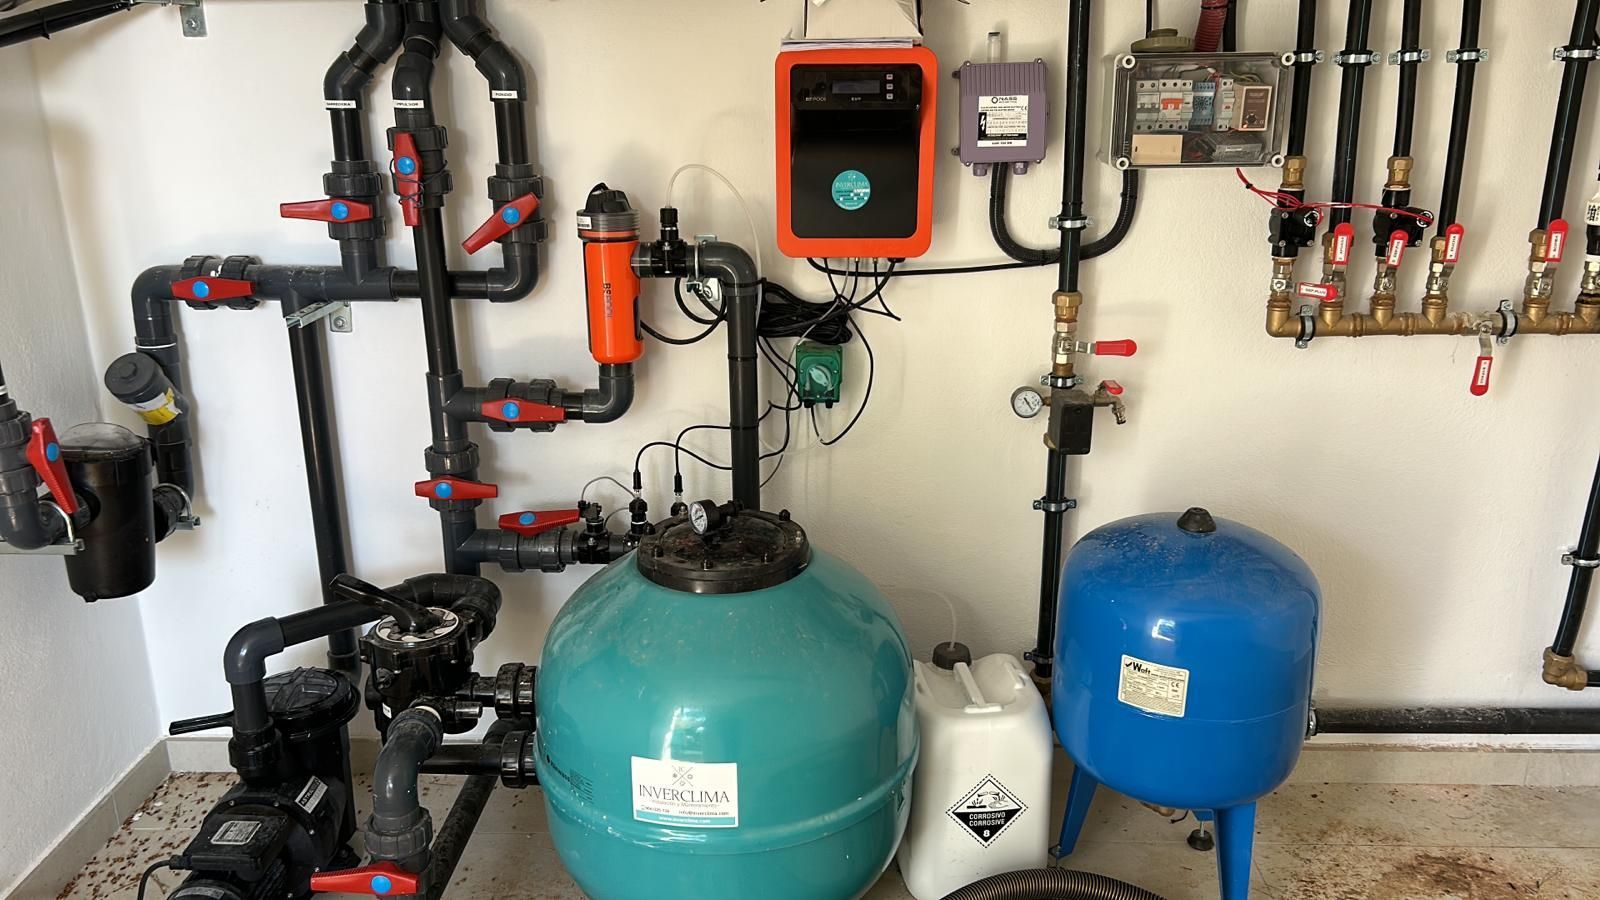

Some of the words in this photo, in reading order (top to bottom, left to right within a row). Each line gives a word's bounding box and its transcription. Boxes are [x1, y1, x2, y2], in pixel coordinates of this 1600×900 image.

[639, 784, 730, 803] INVERCLIMA
[969, 812, 1006, 820] CORROSIVO
[969, 819, 1005, 827] CORROSIVE
[983, 829, 991, 838] 8
